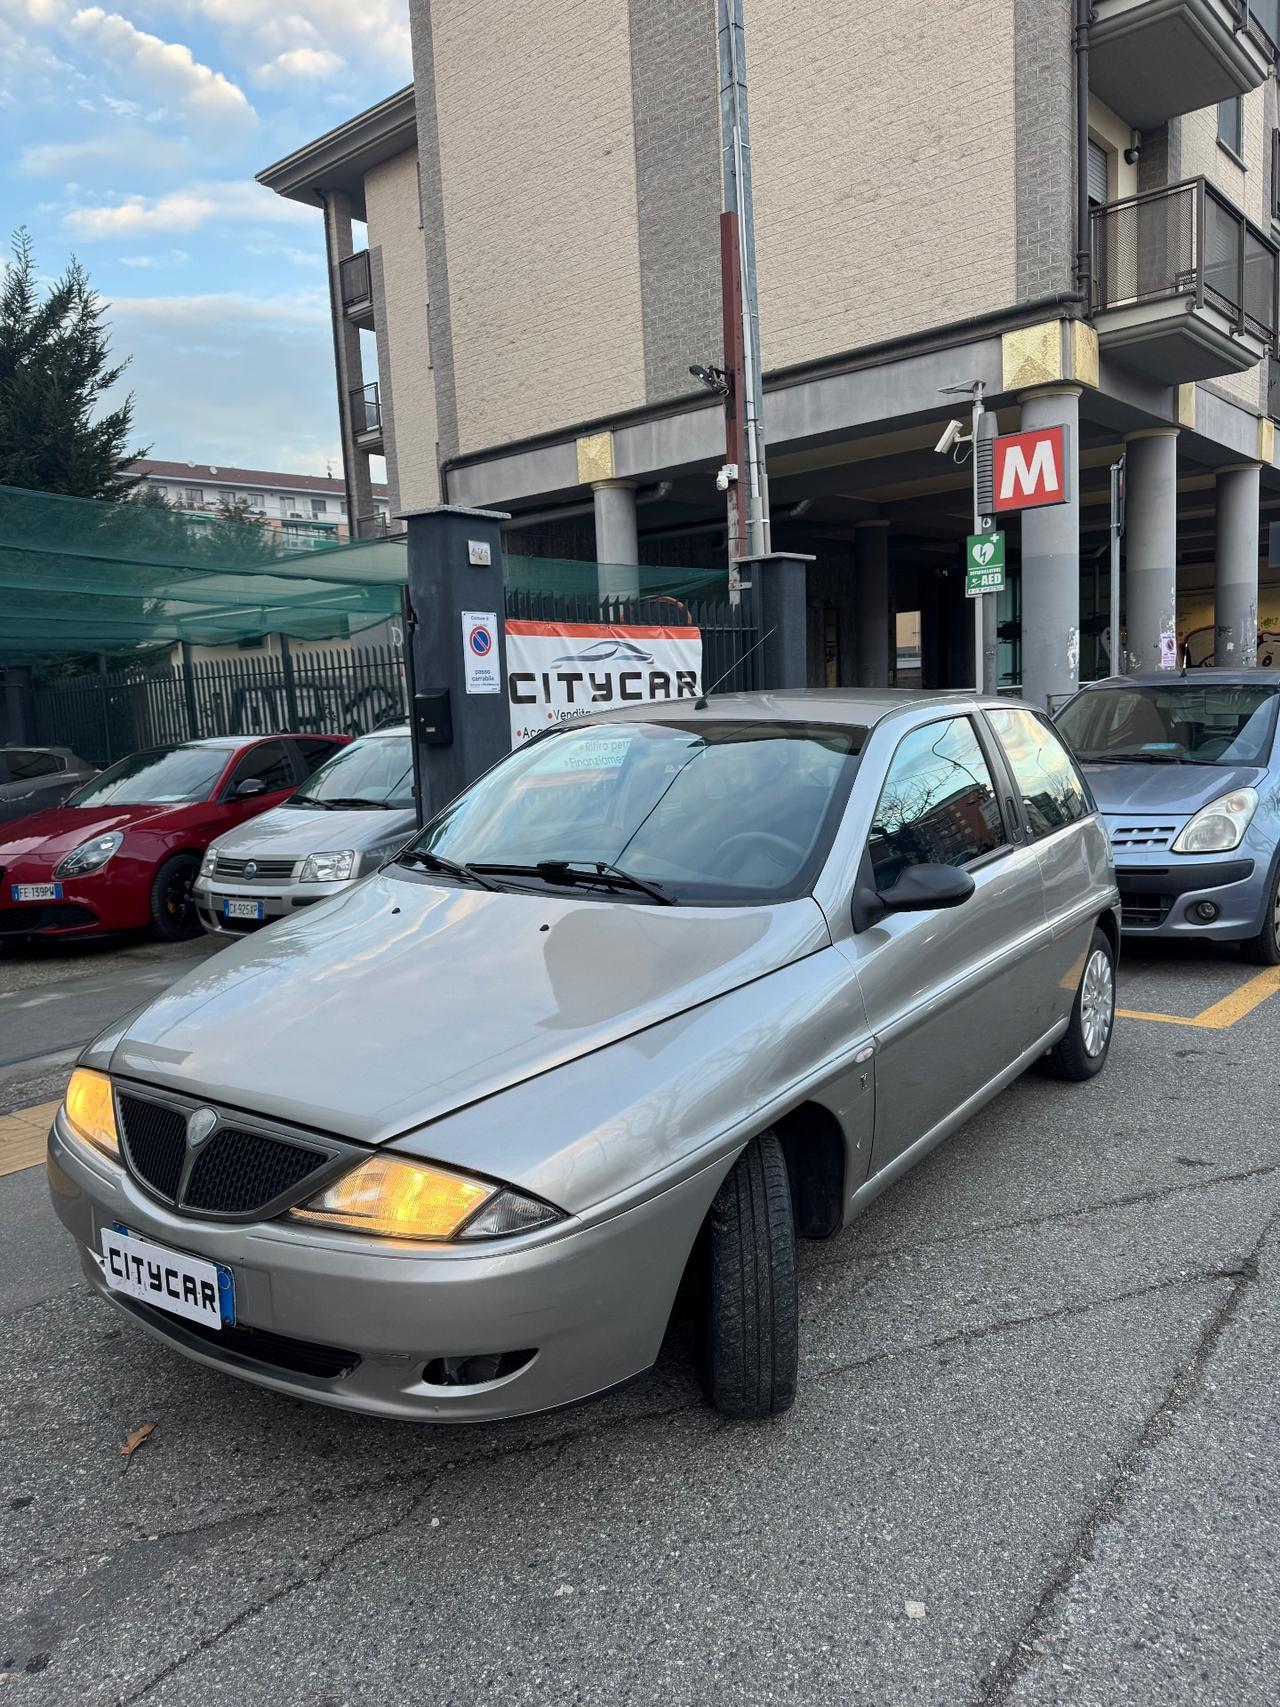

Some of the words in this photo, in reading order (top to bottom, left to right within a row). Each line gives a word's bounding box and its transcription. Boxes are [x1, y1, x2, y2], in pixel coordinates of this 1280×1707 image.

[1000, 440, 1059, 499] M
[981, 573, 1002, 586] AED
[509, 671, 698, 704] CITYCAR
[109, 1247, 217, 1313] CITYCAR
